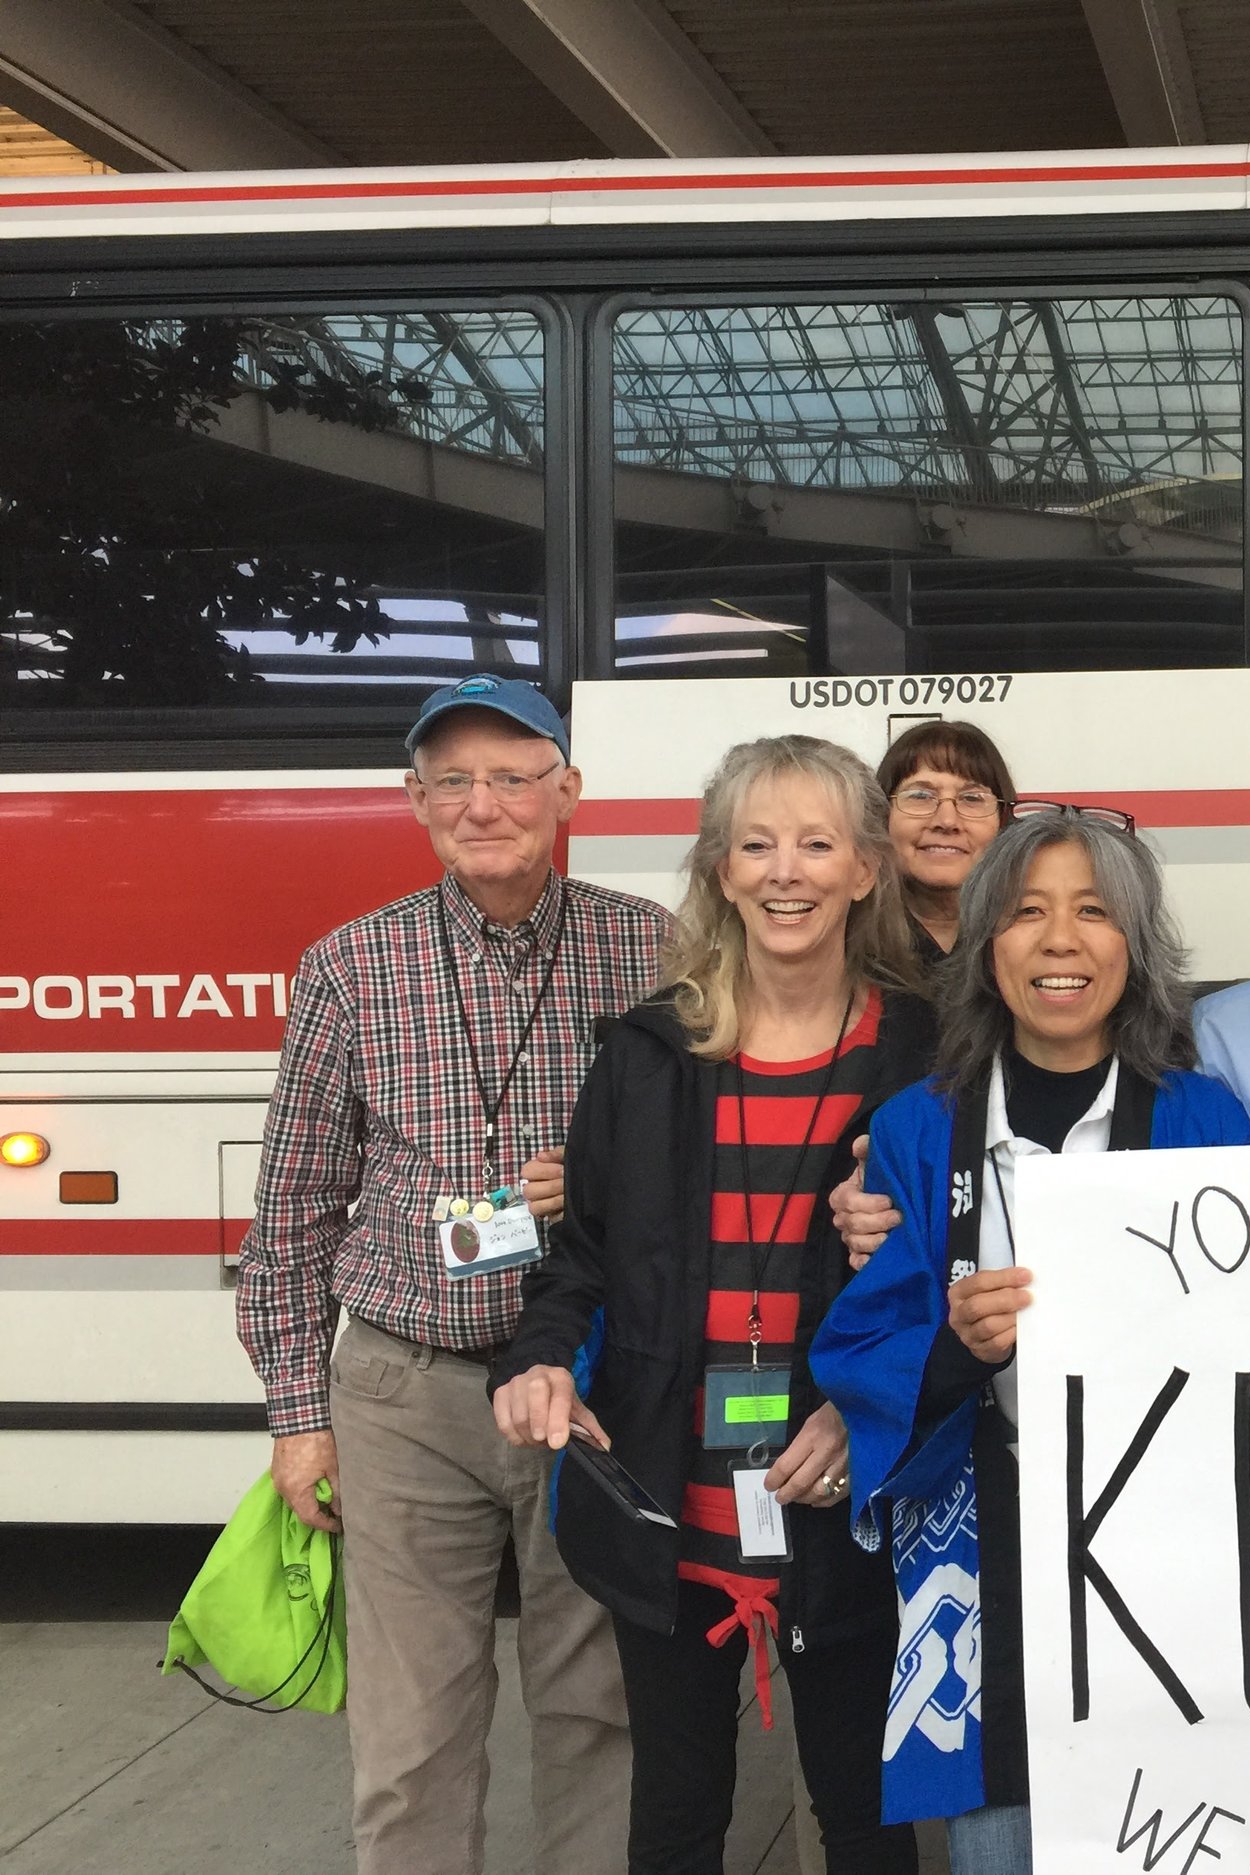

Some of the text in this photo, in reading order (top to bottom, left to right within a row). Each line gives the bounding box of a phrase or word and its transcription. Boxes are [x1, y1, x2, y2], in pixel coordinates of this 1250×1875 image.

[790, 675, 1013, 709] USDOT 079027
[0, 973, 299, 1020] PORTATI
